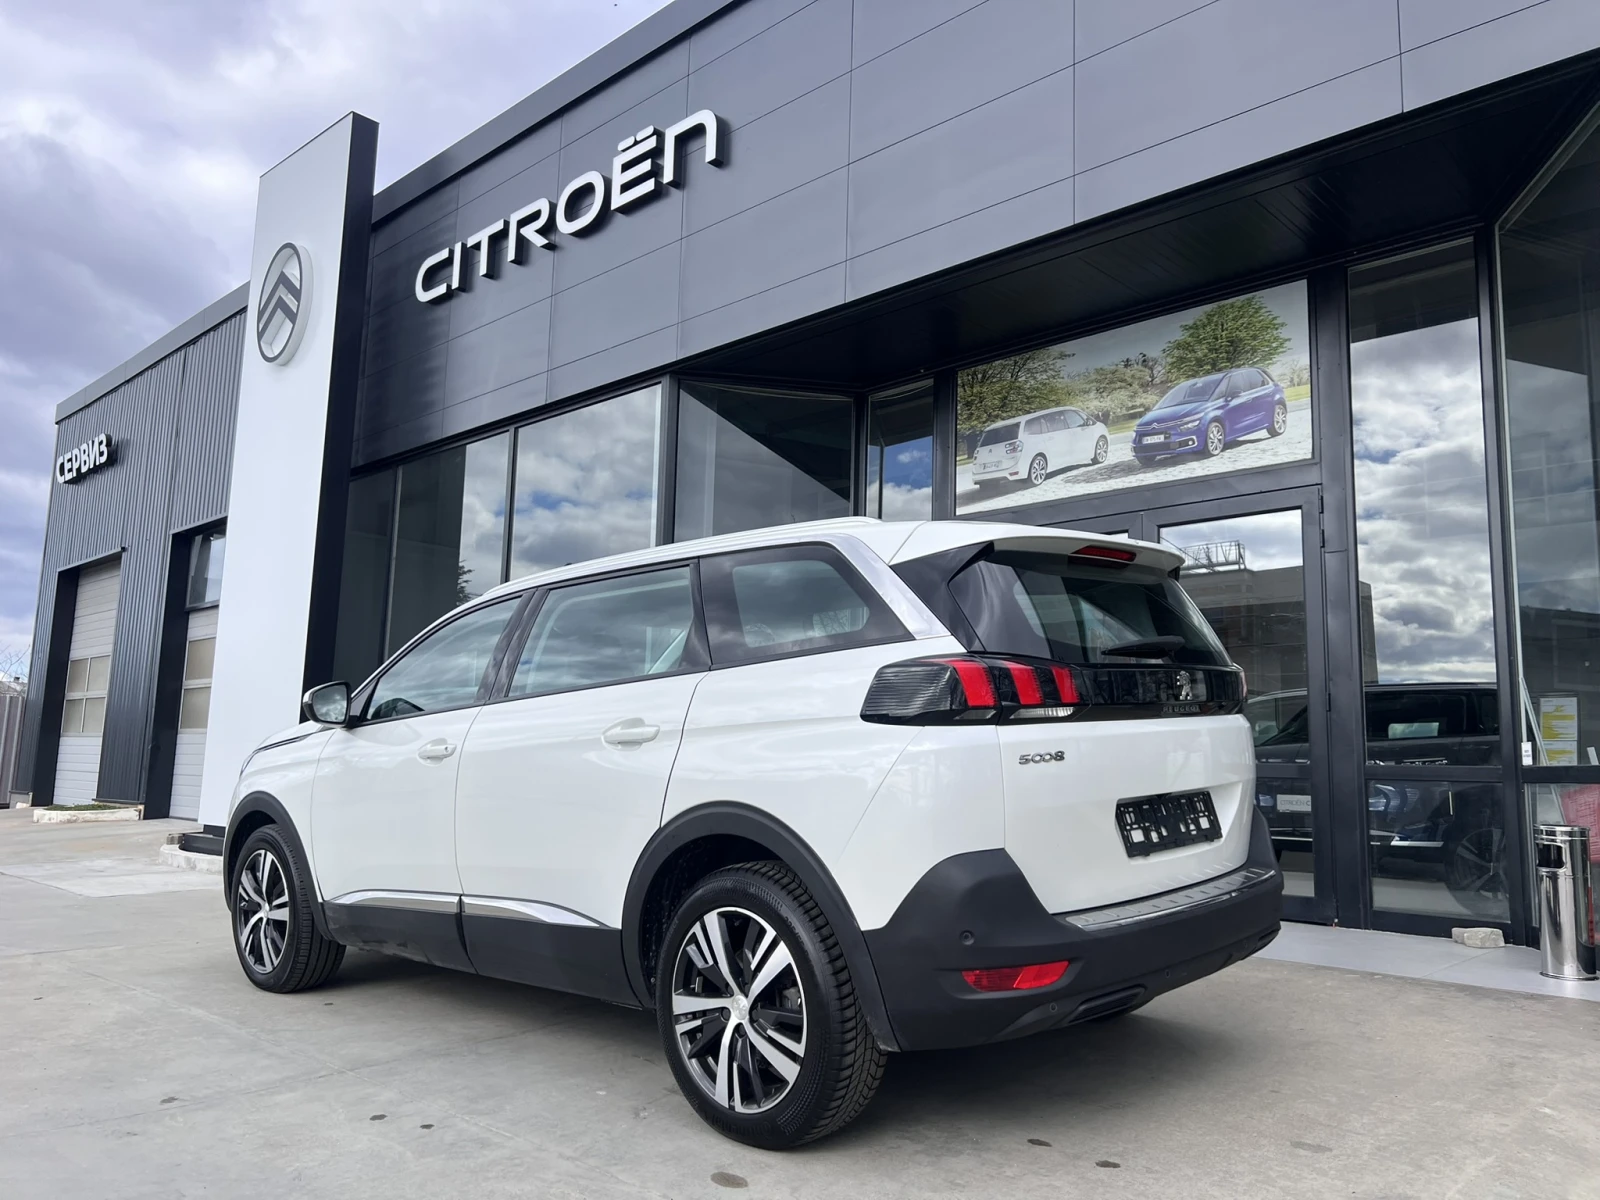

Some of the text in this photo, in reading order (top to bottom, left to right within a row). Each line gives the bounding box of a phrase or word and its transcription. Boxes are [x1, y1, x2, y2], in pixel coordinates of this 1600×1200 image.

[415, 109, 719, 303] CITROËN
[56, 432, 108, 484] СЕРВИЗ
[1162, 704, 1200, 713] PEUGEOT
[1018, 751, 1065, 765] 5008
